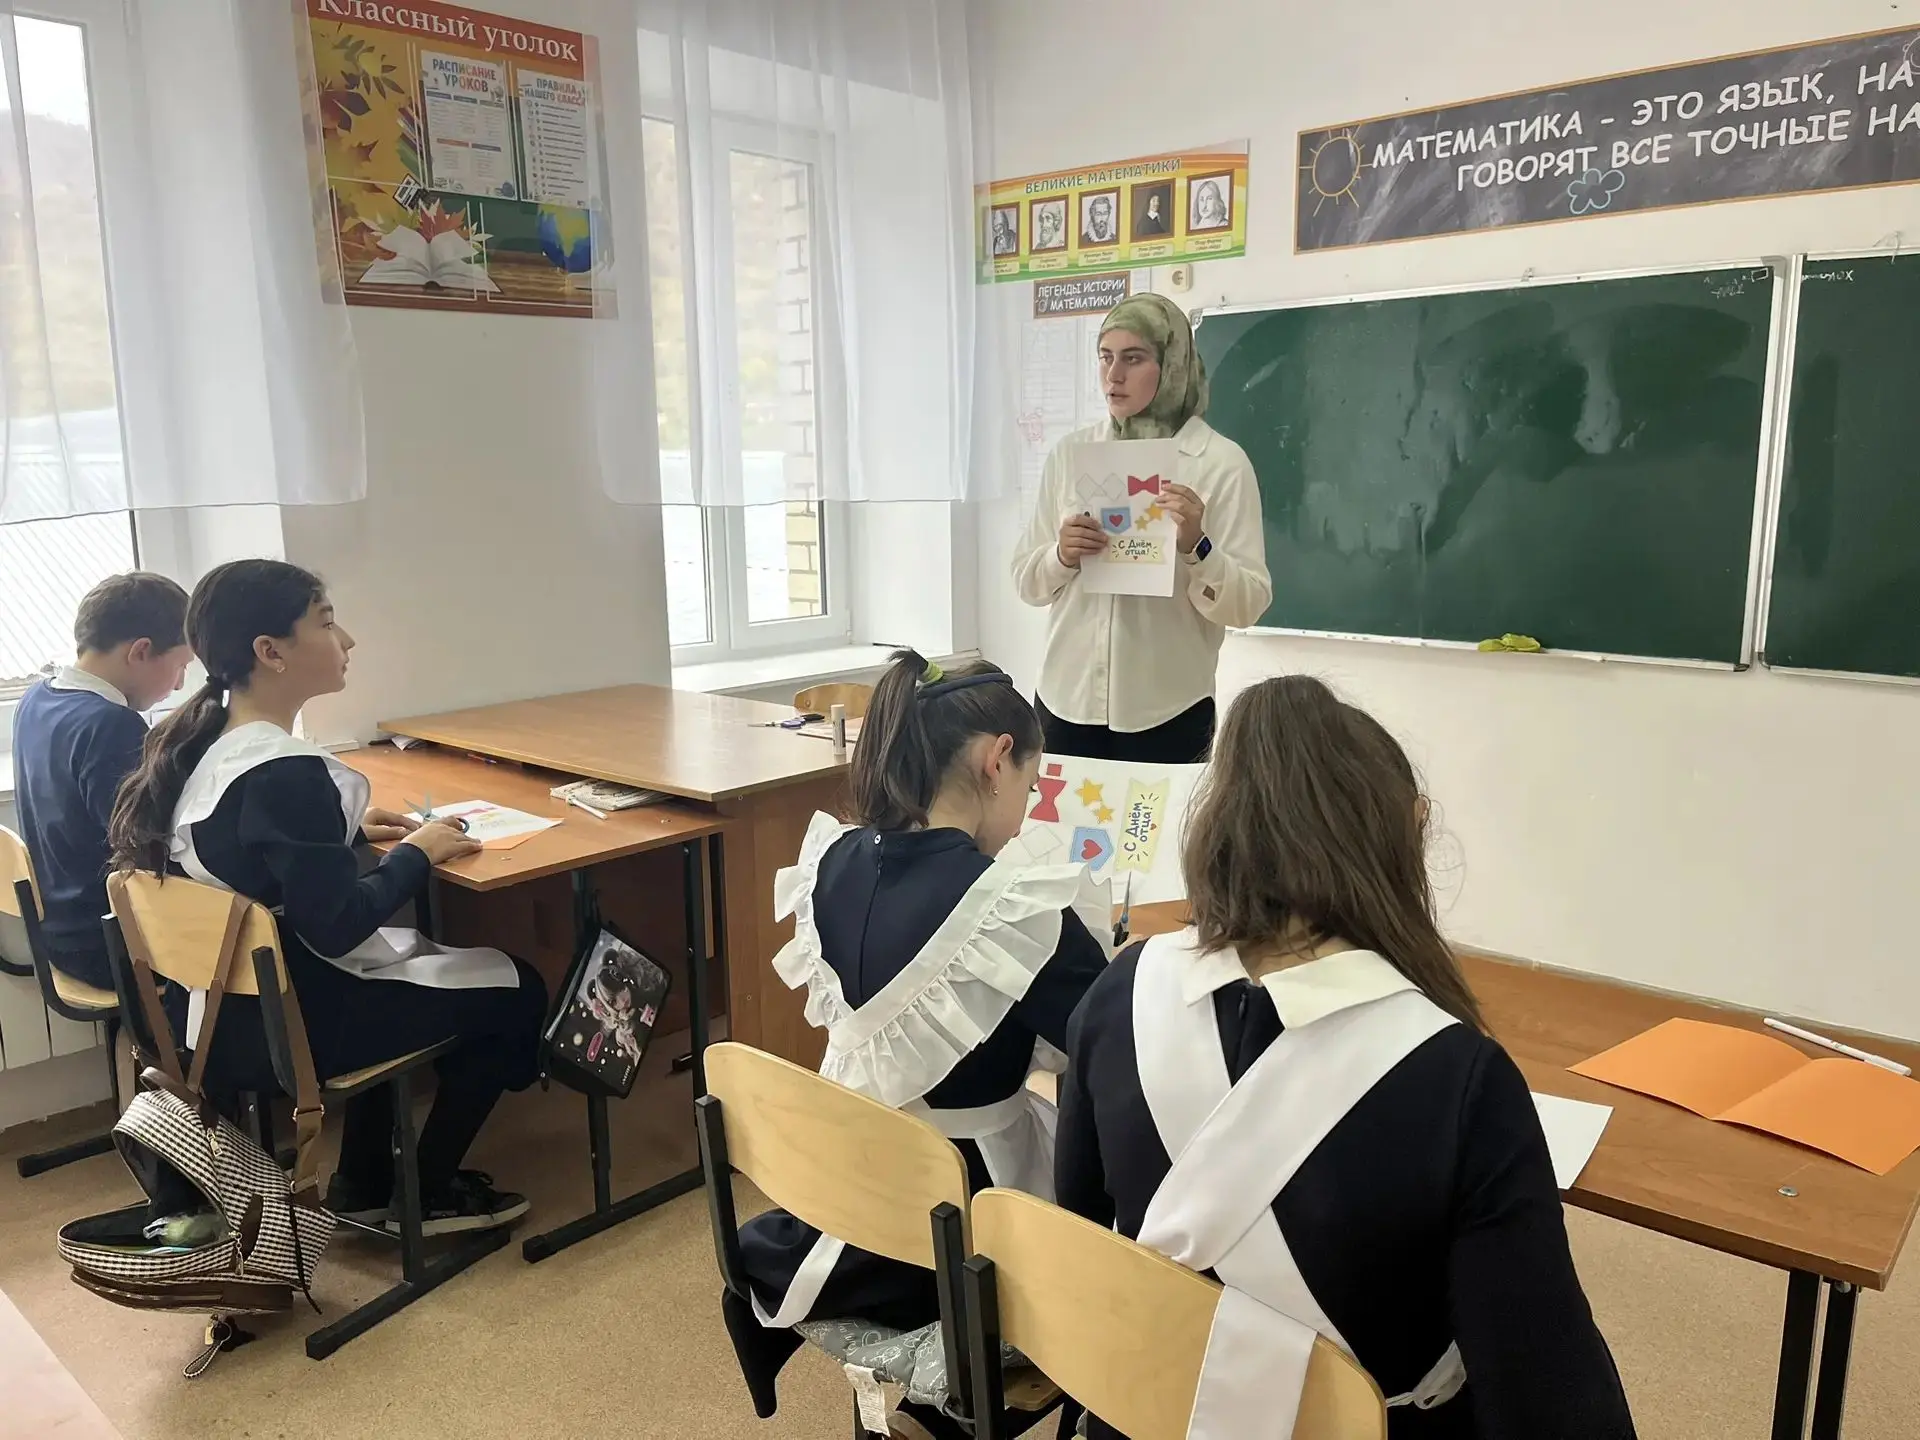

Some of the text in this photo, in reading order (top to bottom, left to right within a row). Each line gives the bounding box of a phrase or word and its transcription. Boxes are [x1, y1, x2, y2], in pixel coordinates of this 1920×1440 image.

[317, 0, 578, 62] Классный уголок
[432, 59, 497, 81] РАСПИСАНИЕ
[443, 73, 489, 93] УРОКОВ
[536, 78, 577, 94] ПРАВИЛА
[524, 88, 555, 101] НАШЕГО
[1372, 110, 1583, 168] МАТЕМАТИКА
[1631, 91, 1704, 126] ЭТО
[1716, 72, 1834, 115] ЯЗЫК,
[1857, 60, 1914, 95] НА
[1457, 146, 1598, 192] ГОВОРЯТ
[1610, 133, 1673, 169] ВСЕ
[1687, 109, 1851, 157] ТОЧНЫЕ
[1025, 158, 1182, 194] ВЕЛИКИЕ МАТЕМАТИКИ
[1038, 278, 1126, 298] ЛЕГЕНДЫ ИСТОРИИ
[1049, 295, 1112, 311] МАТЕМАТИКИ
[1118, 539, 1152, 549] С Днём
[1125, 548, 1150, 556] отца!
[1124, 802, 1143, 852] С Днём
[1139, 805, 1153, 842] отца!
